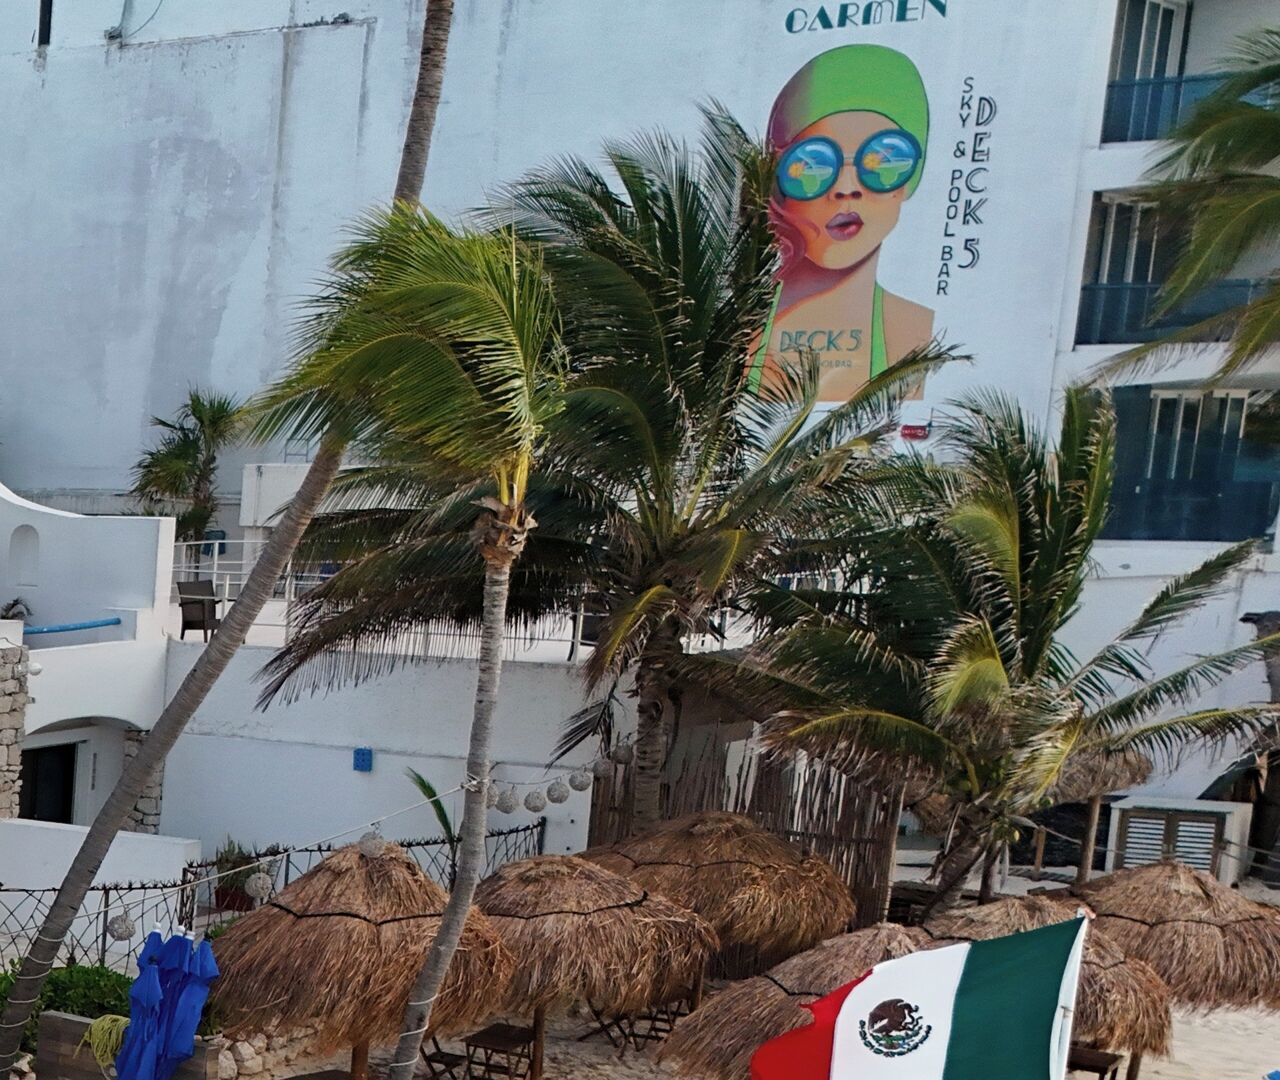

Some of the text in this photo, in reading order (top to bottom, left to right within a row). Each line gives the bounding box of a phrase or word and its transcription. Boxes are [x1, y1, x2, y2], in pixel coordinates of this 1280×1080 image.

[785, 0, 947, 34] CARMEN
[959, 76, 974, 128] SKY
[944, 169, 963, 237] POOL
[957, 96, 997, 269] DECK 5
[936, 245, 953, 296] BAR
[780, 328, 863, 353] DECK 5
